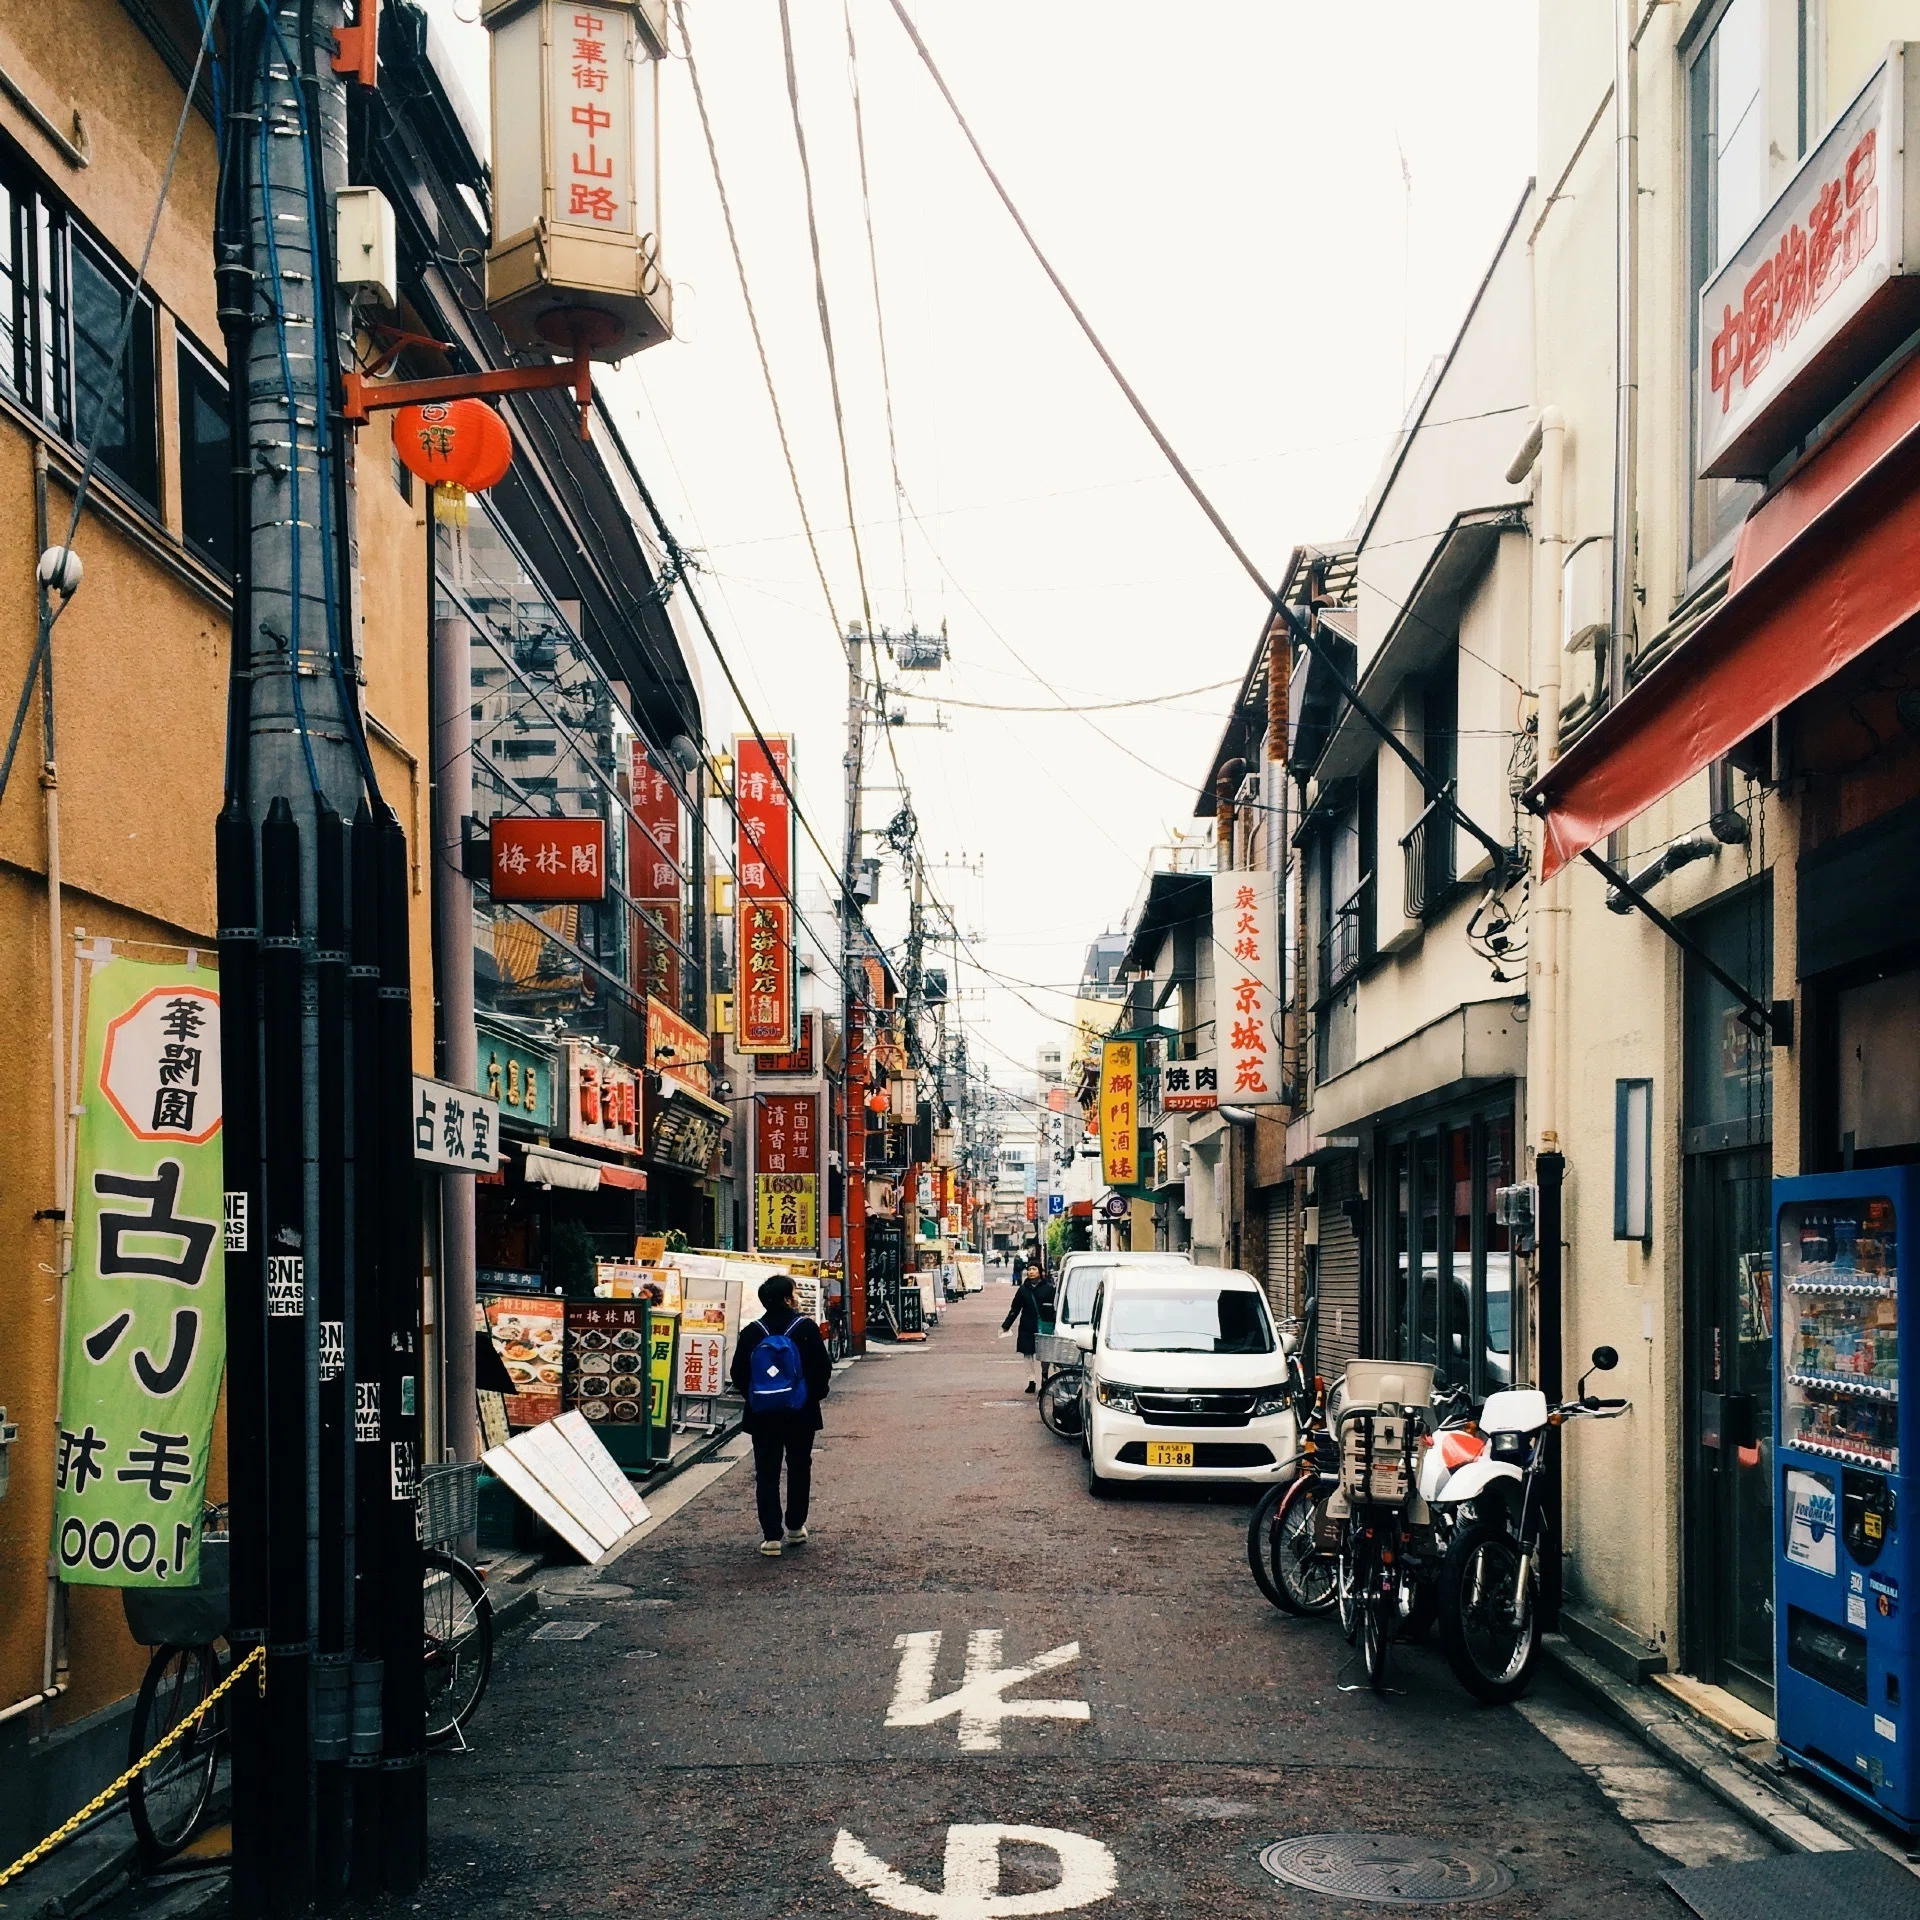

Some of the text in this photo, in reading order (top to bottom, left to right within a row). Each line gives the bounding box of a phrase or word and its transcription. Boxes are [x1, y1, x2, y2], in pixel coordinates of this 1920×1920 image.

[568, 12, 619, 222] 中華街 中山路
[497, 841, 598, 878] 梅林閣
[1234, 885, 1260, 961] 炭火焼
[749, 908, 780, 993] 龍海飯店
[1230, 977, 1268, 1094] 京城苑
[1165, 1067, 1217, 1092] 焼肉
[1168, 1096, 1216, 1109] キリンビール
[416, 1089, 490, 1163] 占教室
[792, 1101, 809, 1159] 中国料理
[767, 1105, 788, 1172] 清香園
[224, 1195, 245, 1219] NE
[780, 1194, 798, 1235] 食べ放題
[224, 1221, 245, 1235] AS
[268, 1259, 303, 1283] BNE
[476, 1271, 532, 1285] の御案内
[268, 1286, 303, 1299] WAS
[268, 1301, 303, 1314] HERE
[586, 1309, 636, 1325] 梅林閣
[319, 1324, 342, 1349] BN
[319, 1351, 344, 1364] WA
[652, 1341, 670, 1360] 居
[684, 1339, 703, 1392] 上海蟹
[707, 1339, 719, 1393] 入荷しました
[356, 1385, 379, 1409] BN
[356, 1412, 380, 1424] WA
[1158, 1452, 1191, 1465] 13-88
